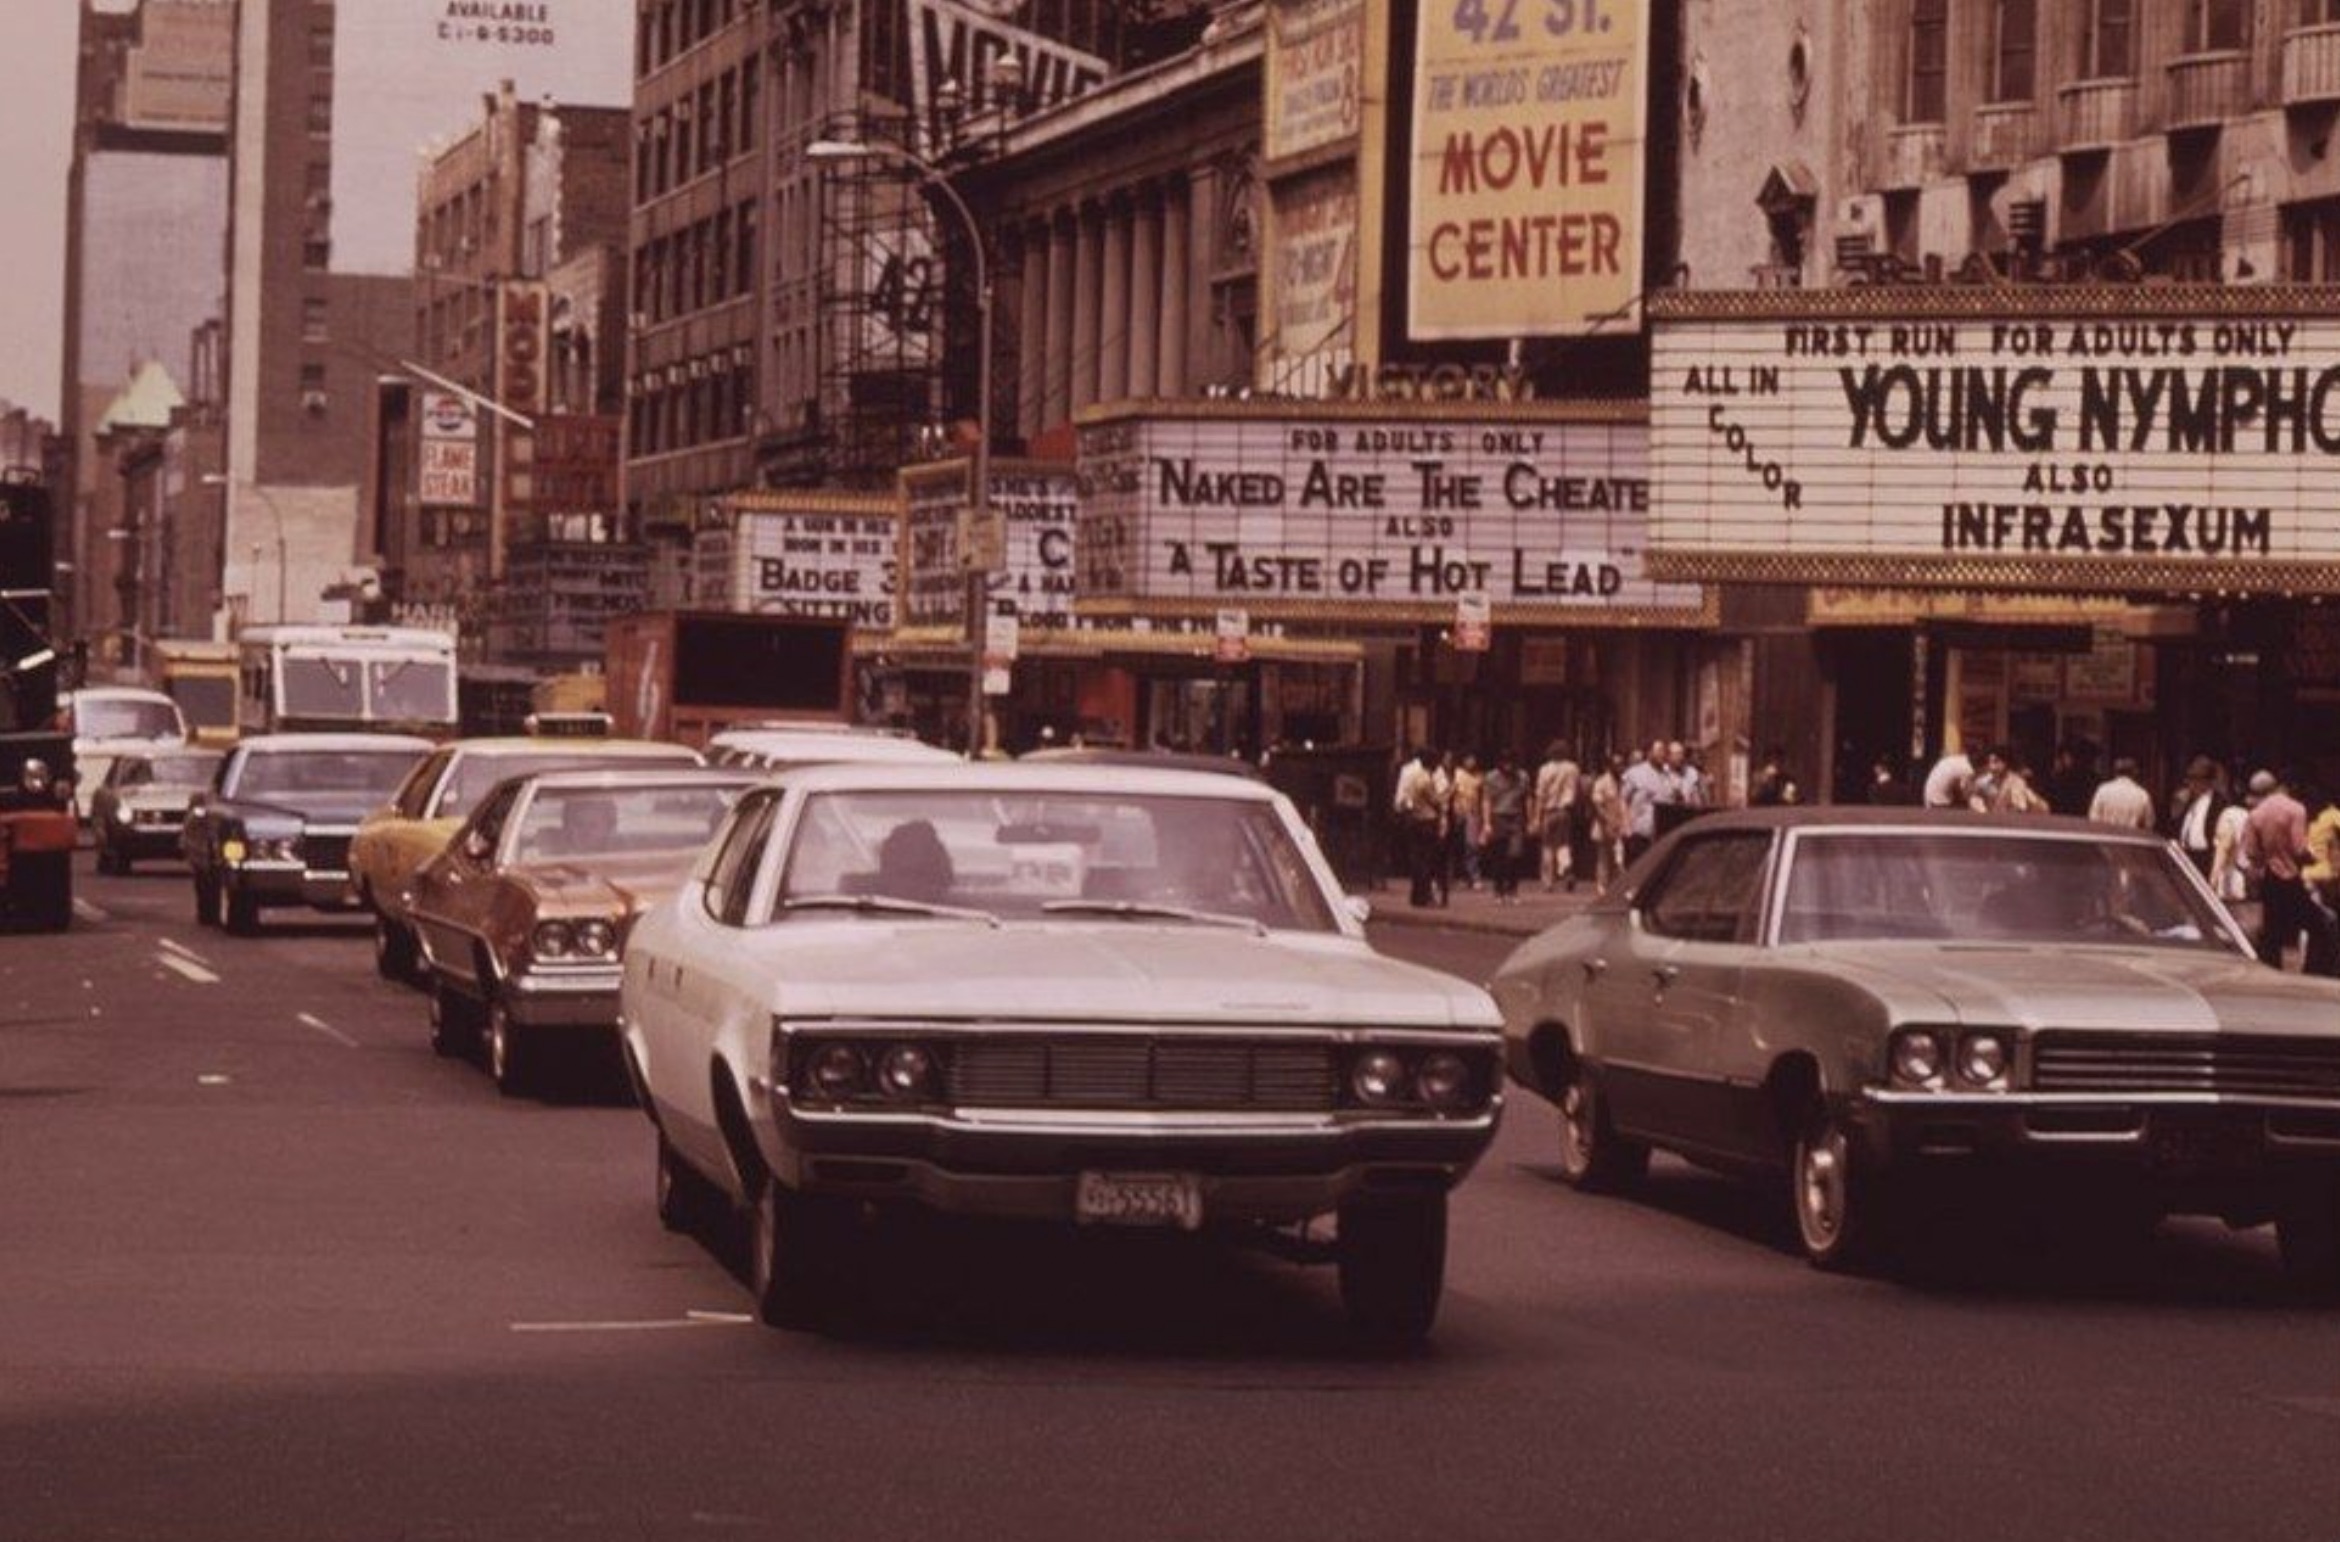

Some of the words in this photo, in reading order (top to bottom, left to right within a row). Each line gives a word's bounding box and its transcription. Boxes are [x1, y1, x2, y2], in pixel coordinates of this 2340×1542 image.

[447, 0, 547, 22] AVAILABLE
[1439, 121, 1608, 195] MOVIE
[1429, 211, 1621, 282] CENTER
[1784, 325, 1873, 356] FIRST
[1891, 327, 1955, 357] RUN
[1992, 326, 2054, 355] FOR
[2067, 325, 2196, 355] ADULTS
[2213, 326, 2294, 356] ONLY
[1683, 366, 1739, 394] ALL
[1750, 366, 1778, 394] IN
[1839, 364, 2056, 452] YOUNG
[1292, 430, 1338, 452] FOR
[1355, 430, 1453, 453] ADULTS
[1482, 431, 1544, 454] ONLY
[1708, 404, 1801, 509] COLOR
[1300, 459, 1385, 508] ARE
[1412, 461, 1482, 510] THE
[2022, 463, 2113, 493] ALSO
[1385, 516, 1453, 537] ALSO
[1942, 503, 2271, 554] INFRASEXUM
[1206, 543, 1321, 590] TASTE
[1339, 559, 1388, 592] OF
[1411, 548, 1491, 594] HOT
